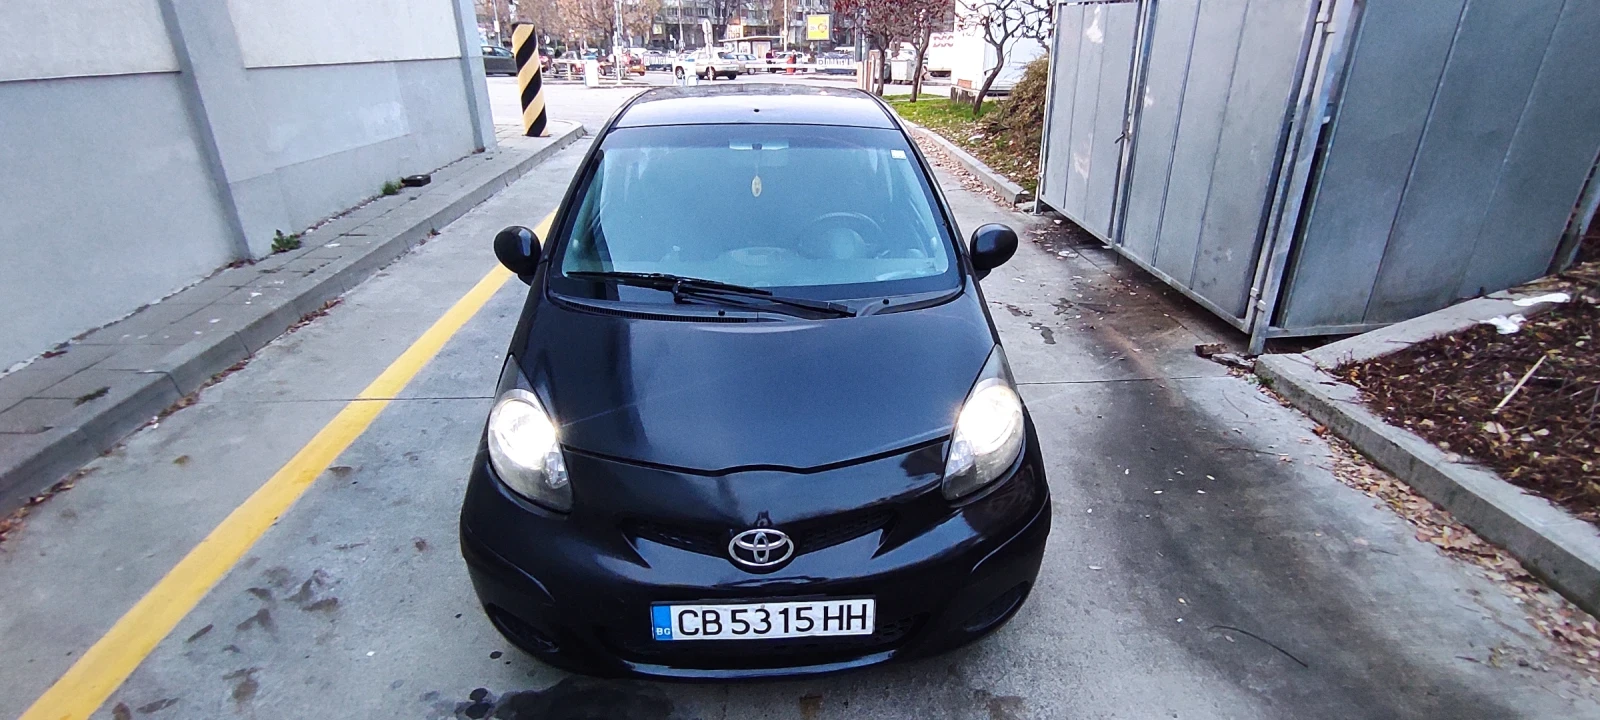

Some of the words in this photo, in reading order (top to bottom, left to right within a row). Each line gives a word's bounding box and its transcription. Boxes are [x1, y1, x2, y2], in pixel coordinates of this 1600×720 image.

[678, 609, 722, 636] CB
[731, 607, 814, 635] 5315
[823, 603, 867, 631] HH
[655, 628, 671, 636] BG
